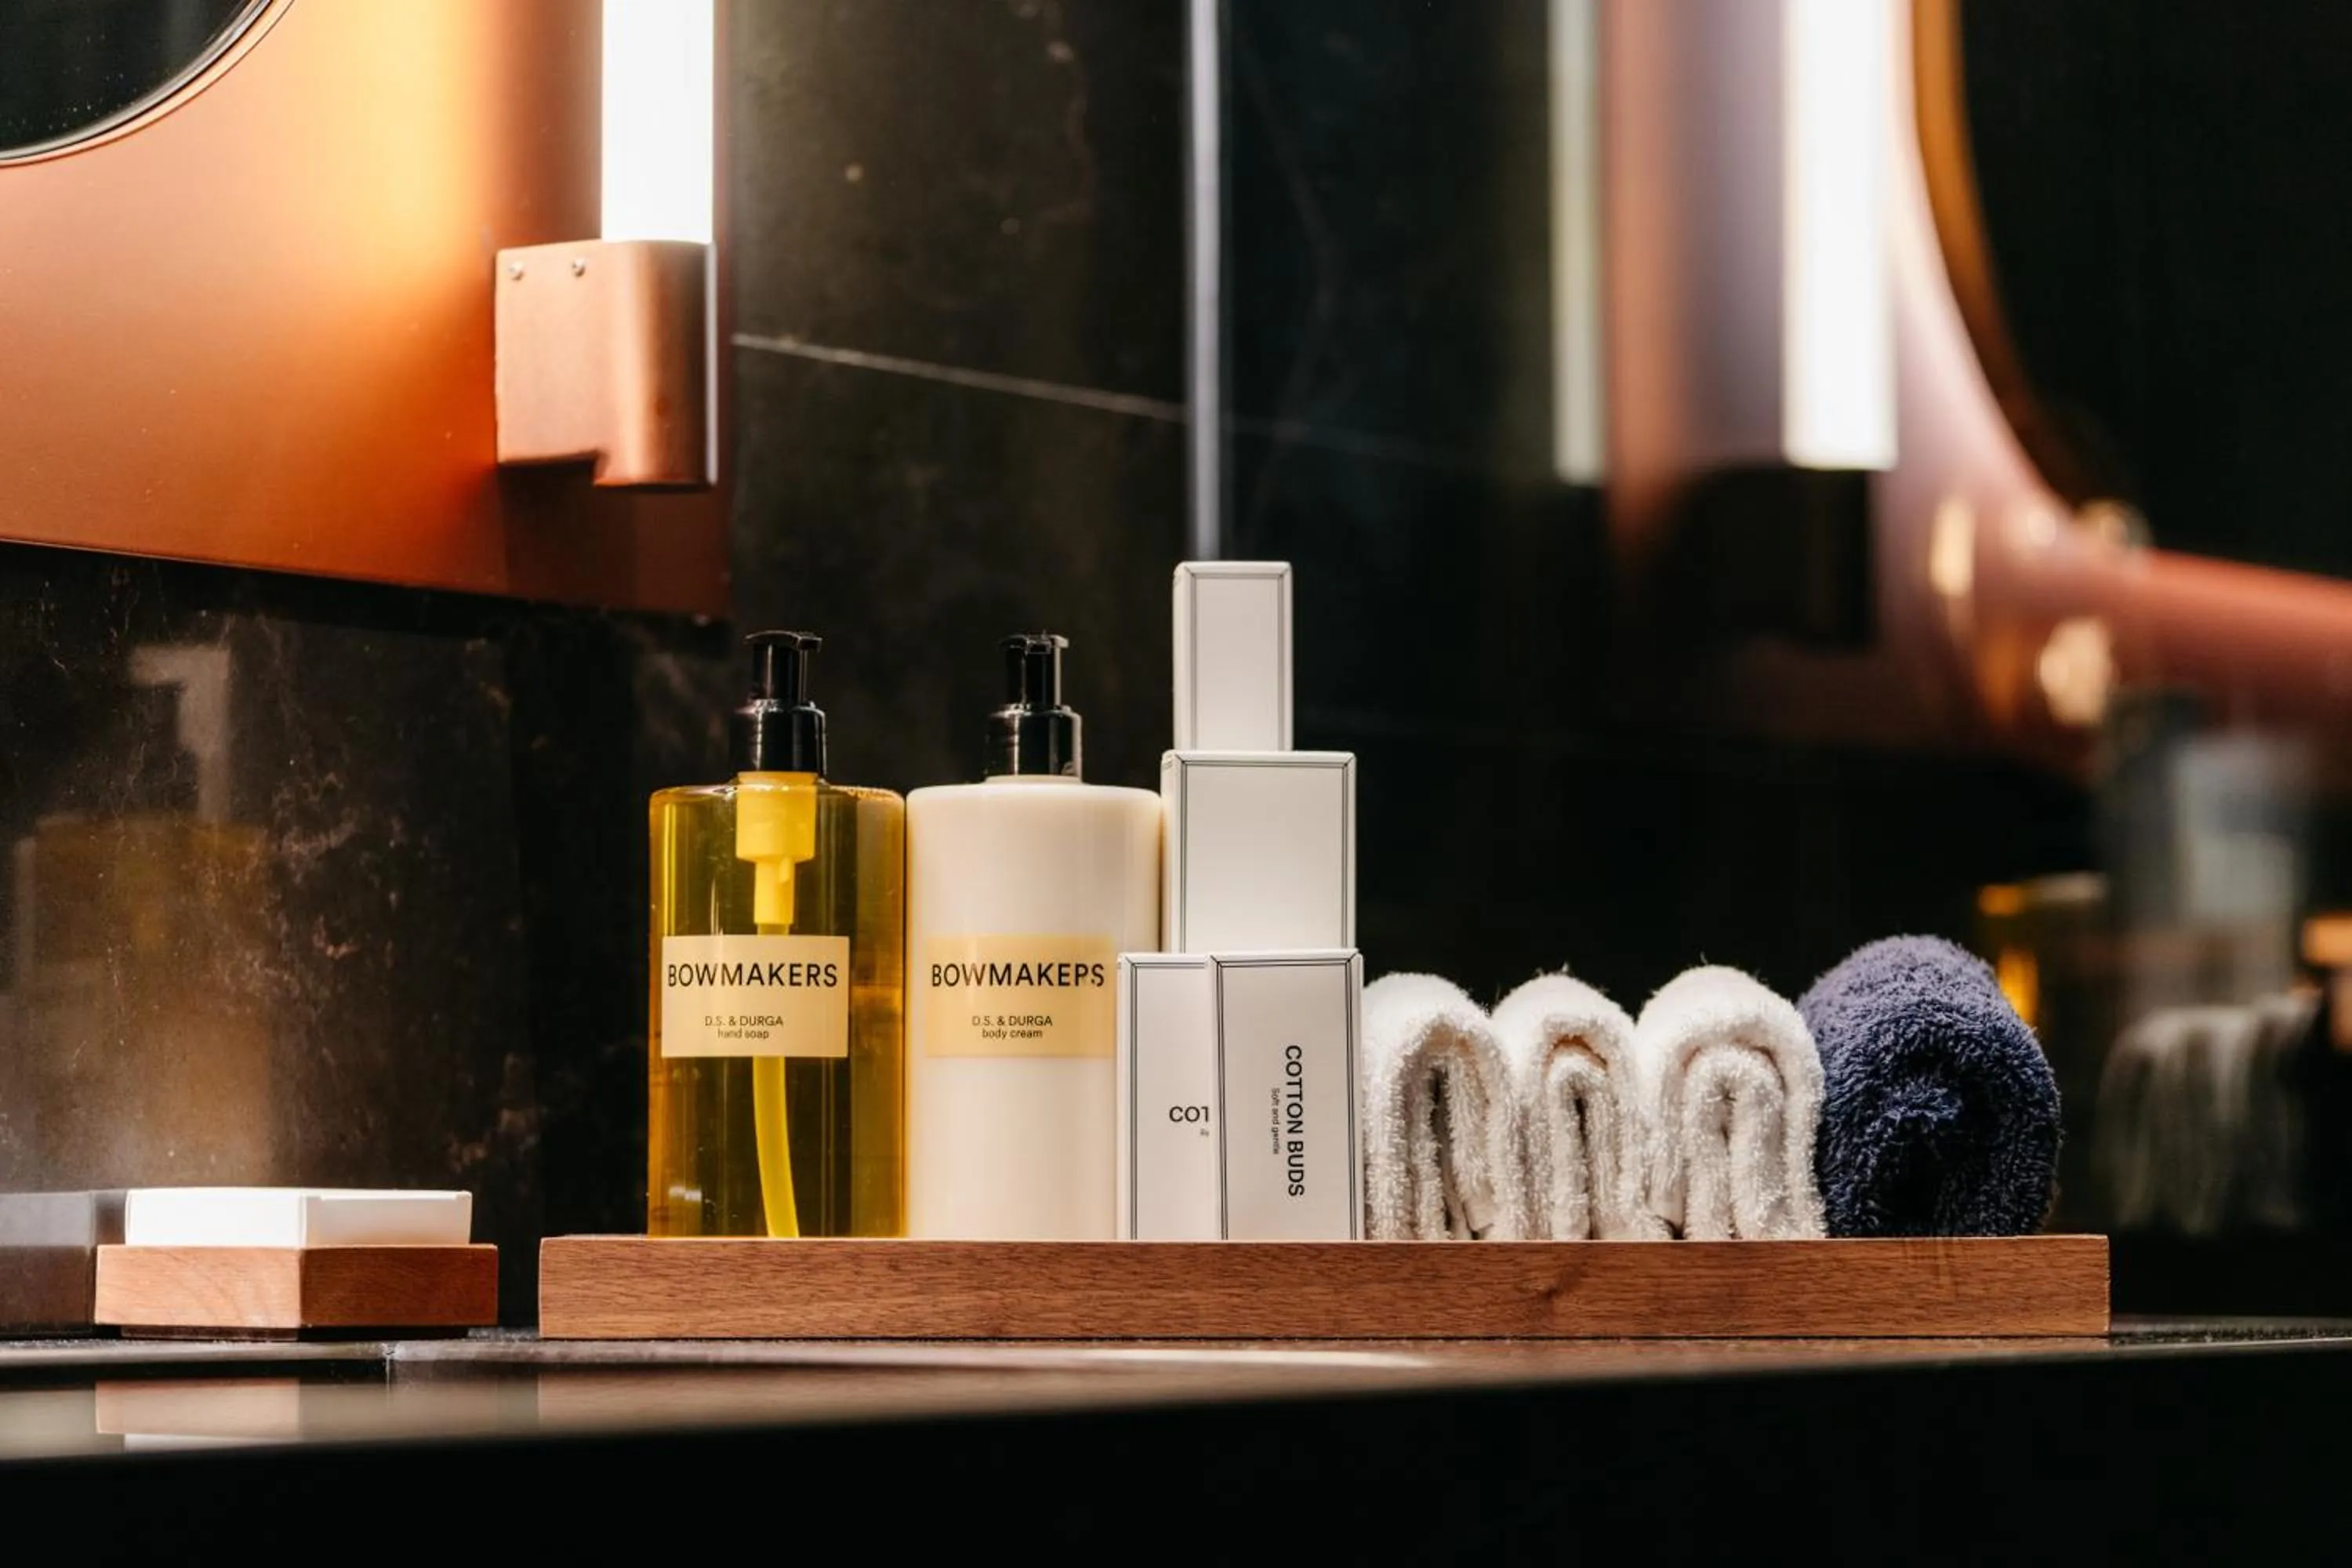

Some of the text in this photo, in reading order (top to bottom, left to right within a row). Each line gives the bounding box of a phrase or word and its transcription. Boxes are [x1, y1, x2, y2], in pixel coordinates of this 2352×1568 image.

[667, 962, 837, 988] BOWMAKERS
[728, 1015, 736, 1026] &
[739, 1015, 784, 1027] DURGA
[996, 1015, 1006, 1026] &
[1008, 1015, 1053, 1026] DURGA
[717, 1027, 770, 1040] hand soap
[982, 1027, 1044, 1040] body cream
[1272, 1108, 1280, 1125] and
[1285, 1045, 1305, 1197] COTTON BUDS
